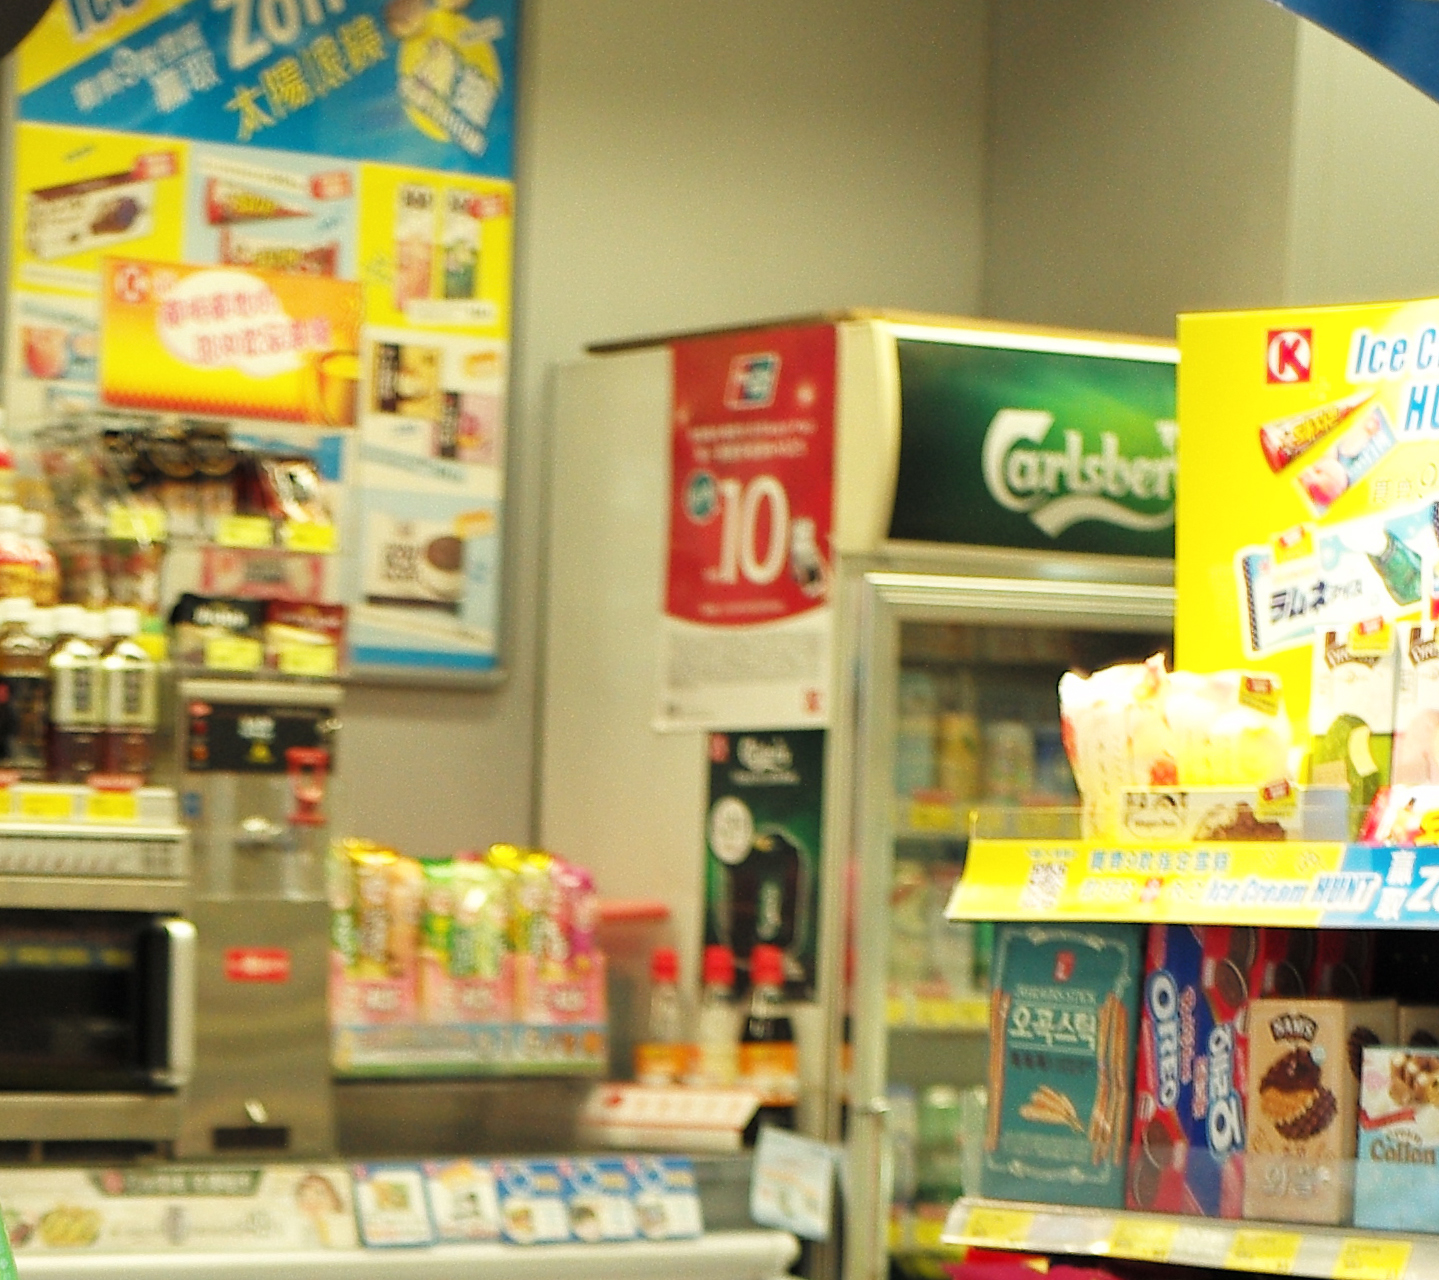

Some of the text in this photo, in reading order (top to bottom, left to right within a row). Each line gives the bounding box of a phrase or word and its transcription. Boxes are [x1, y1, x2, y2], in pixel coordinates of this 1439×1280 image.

[1355, 333, 1406, 376] Ice
[1148, 970, 1181, 1109] OREO
[1368, 1142, 1437, 1168] Collon
